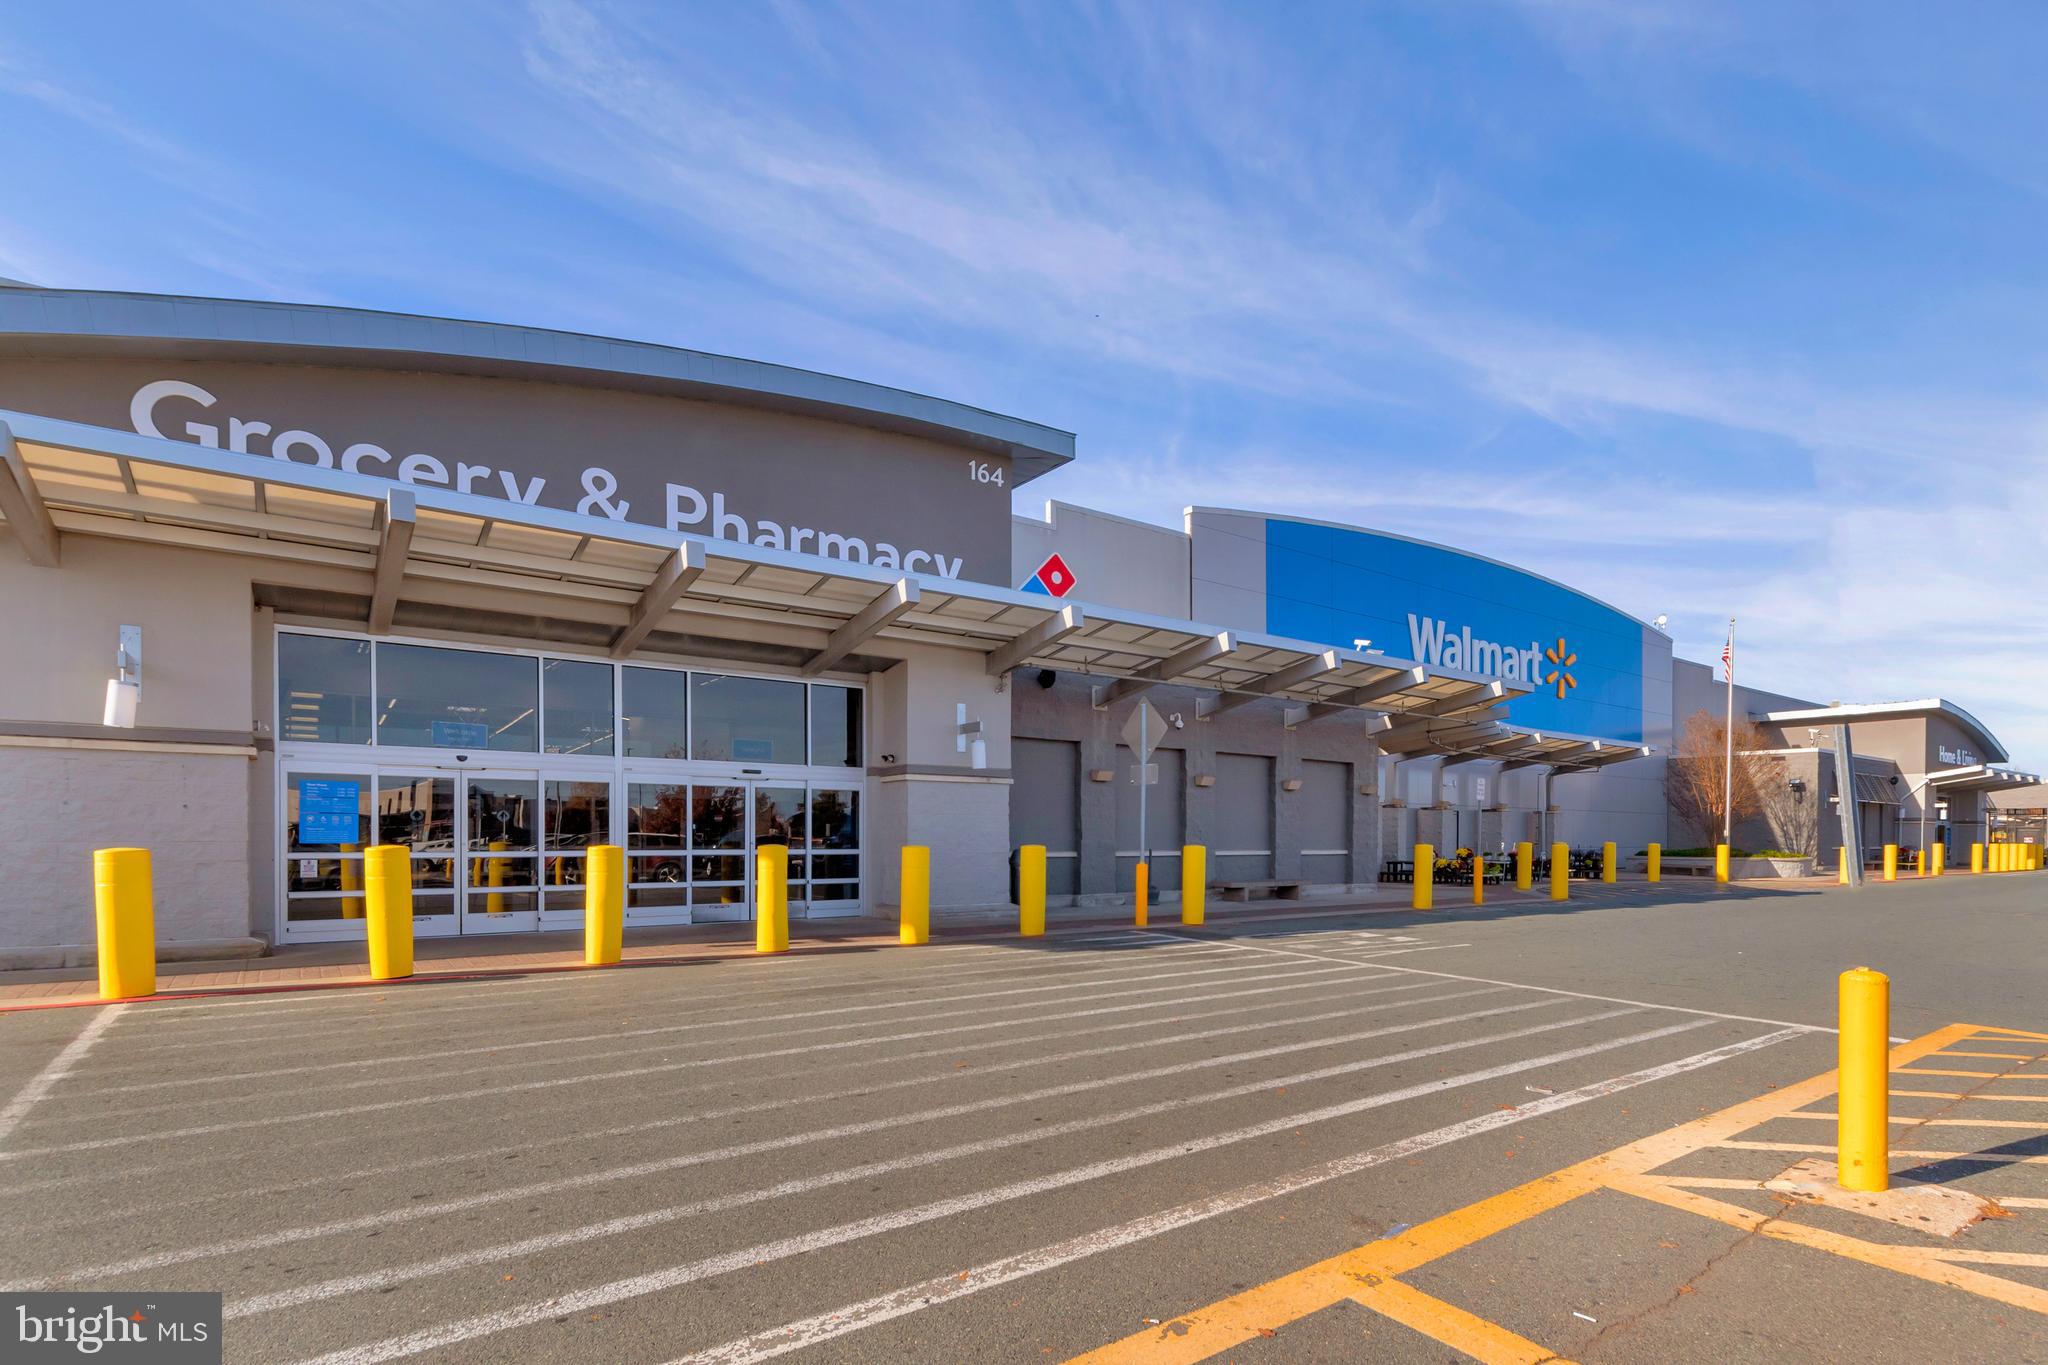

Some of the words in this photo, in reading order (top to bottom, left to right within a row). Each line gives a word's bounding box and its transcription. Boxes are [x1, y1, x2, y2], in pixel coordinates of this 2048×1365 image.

[968, 460, 1005, 487] 164
[576, 467, 630, 522] &
[1407, 613, 1543, 686] Walmart
[1939, 745, 1956, 765] Home
[1956, 749, 1962, 765] &
